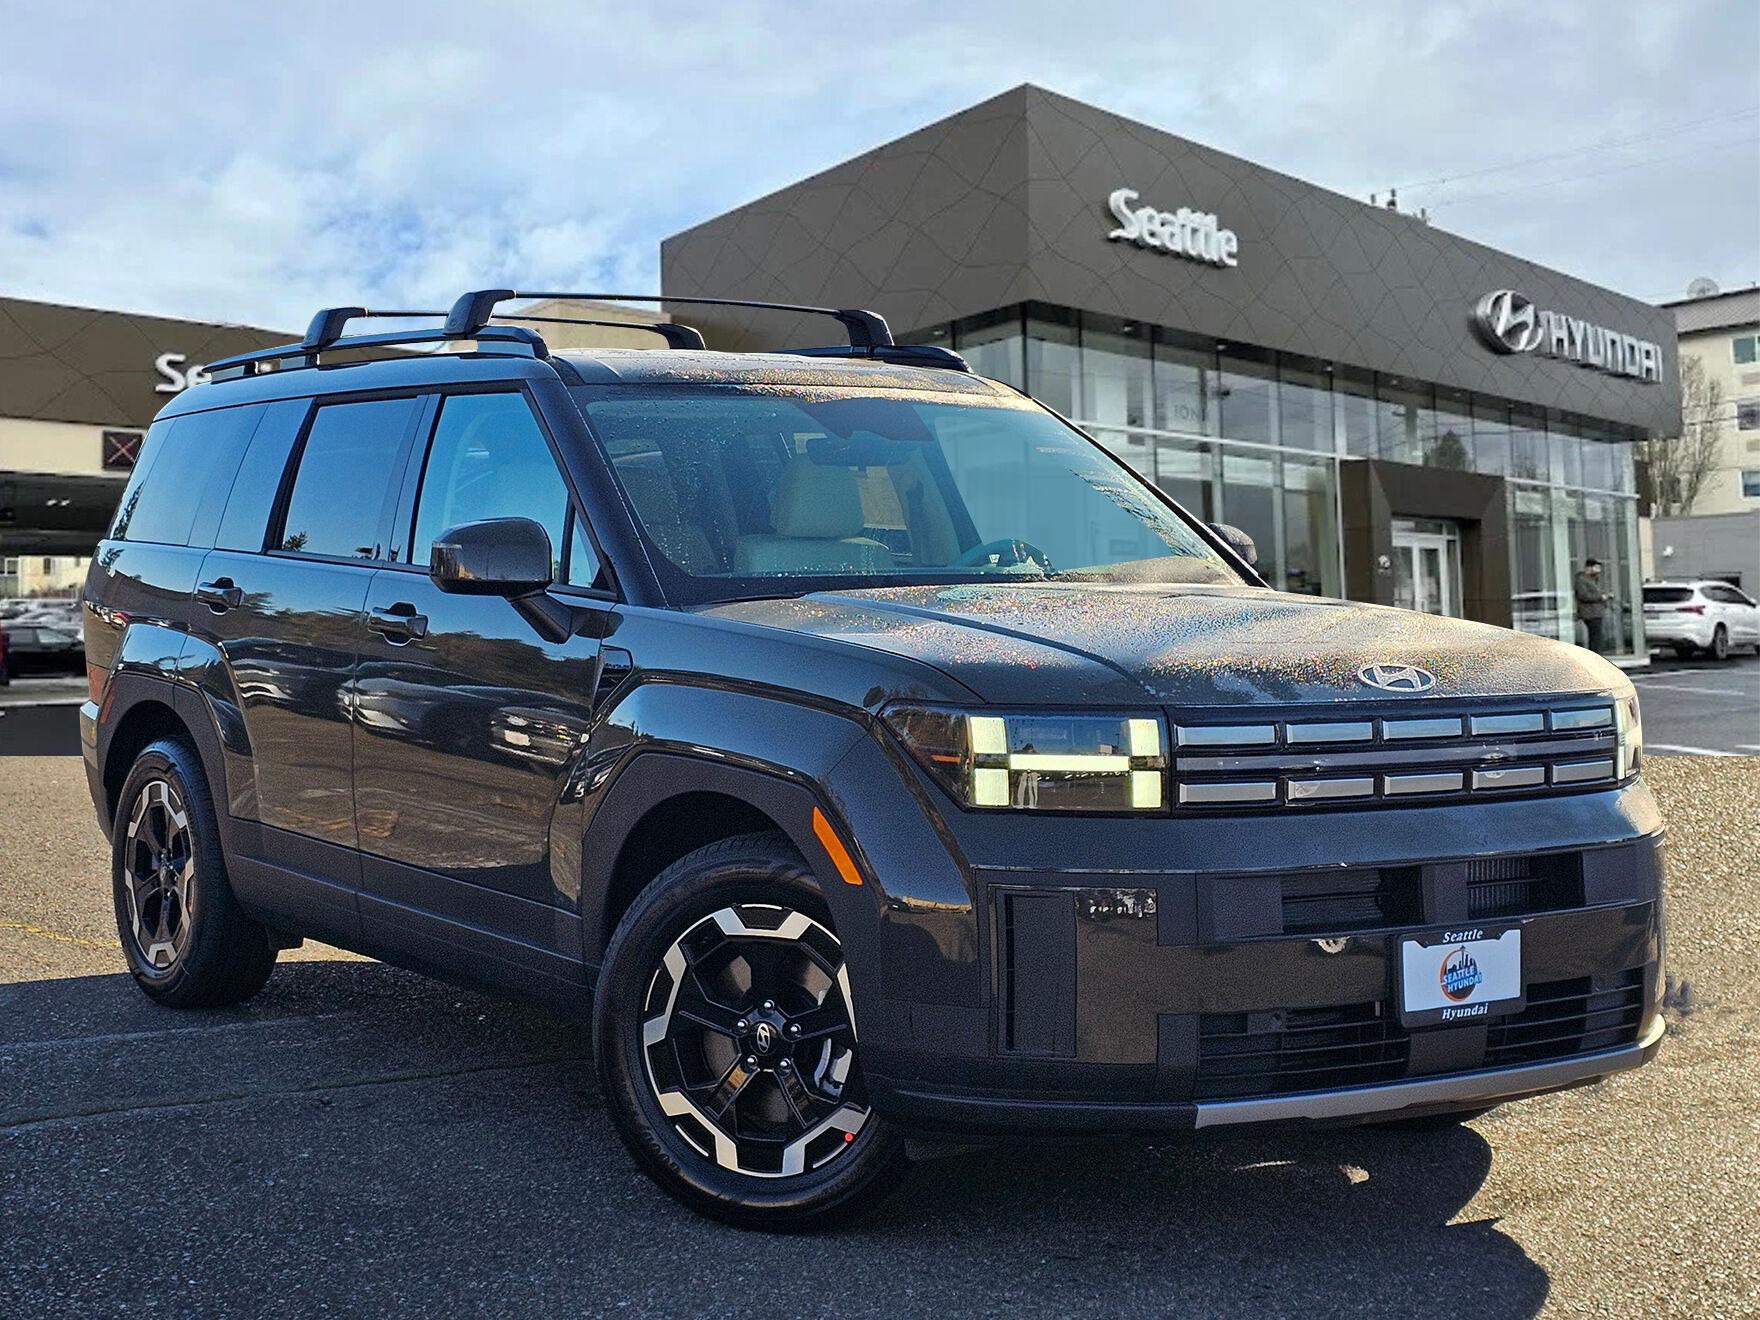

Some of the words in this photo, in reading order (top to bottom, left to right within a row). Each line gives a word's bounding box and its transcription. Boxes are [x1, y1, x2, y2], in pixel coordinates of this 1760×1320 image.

[1108, 188, 1238, 267] Seattle
[1540, 310, 1663, 383] HYUNDAI
[1443, 929, 1483, 943] Seattle
[1443, 965, 1475, 985] SEATTLE
[1442, 1003, 1488, 1020] Hyundai
